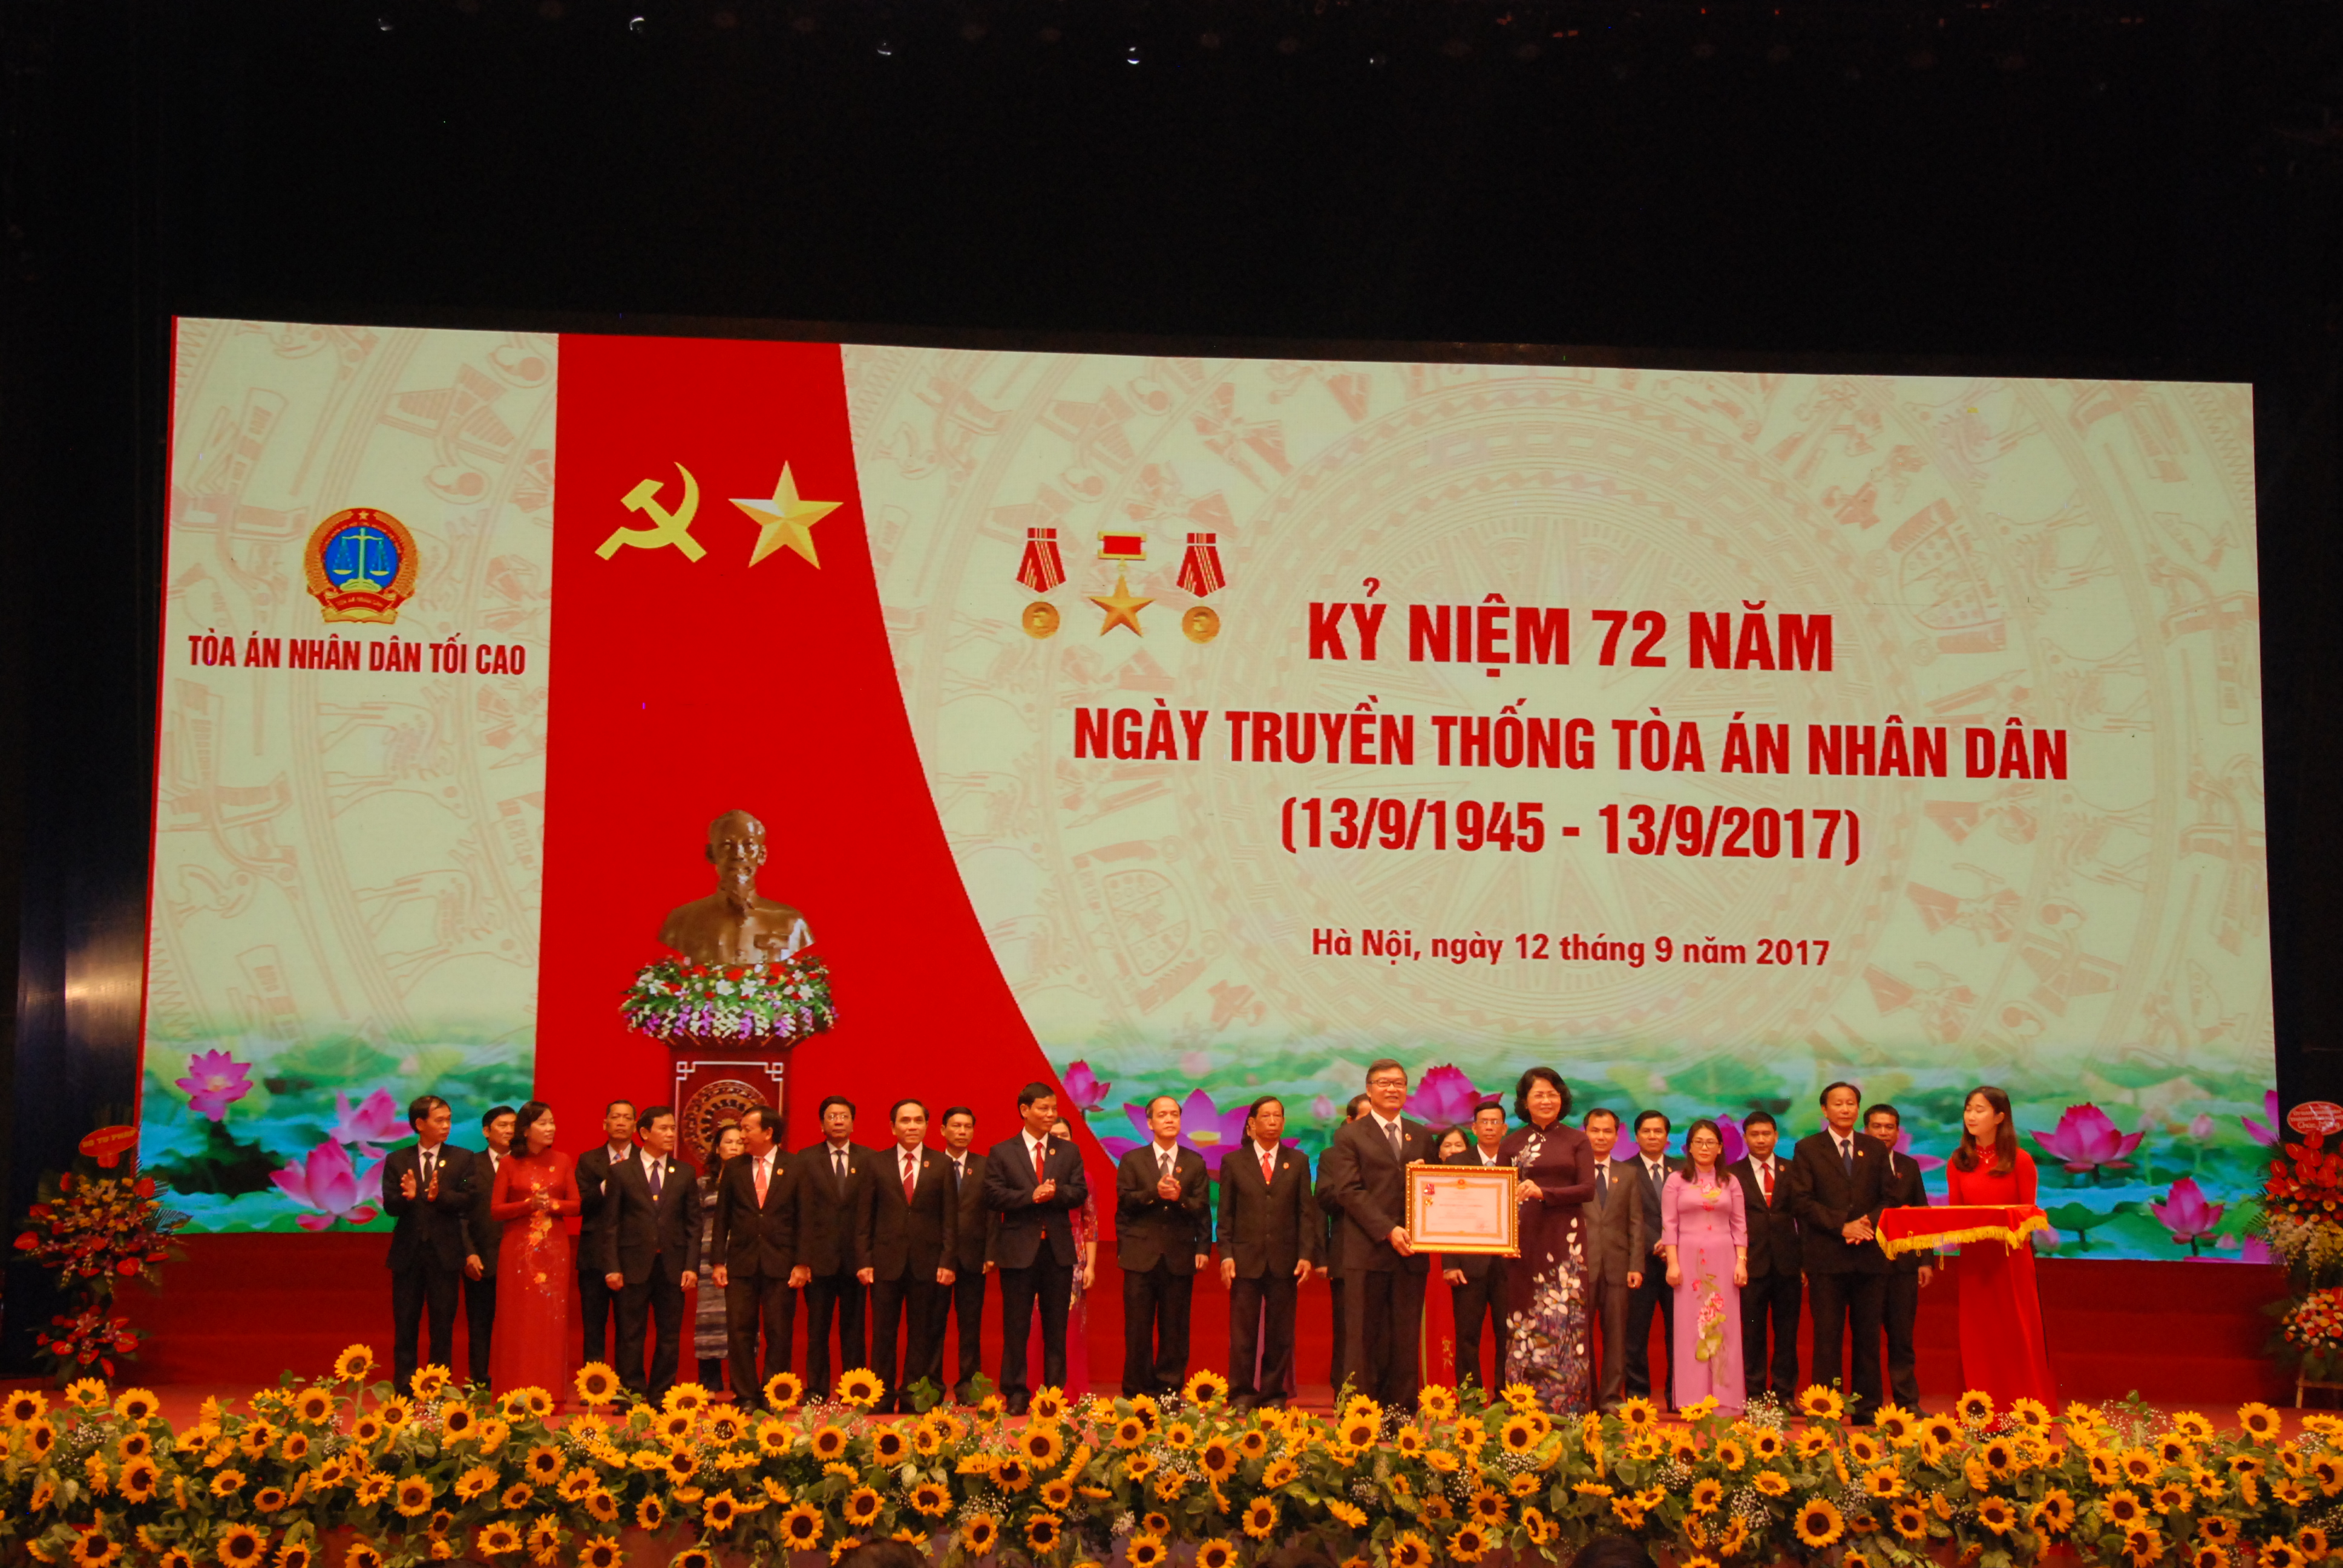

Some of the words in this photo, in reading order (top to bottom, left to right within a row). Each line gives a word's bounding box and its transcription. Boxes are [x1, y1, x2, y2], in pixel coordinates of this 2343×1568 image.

[189, 629, 235, 667] TÒA
[244, 631, 280, 668] ÁN
[289, 634, 360, 670] NHÂN
[370, 636, 421, 672] DÂN
[430, 633, 467, 673] TỐI
[476, 644, 525, 675] CAO
[1309, 578, 1386, 660] KỶ
[1410, 593, 1569, 677] NIỆM
[1592, 610, 1666, 667] 72
[1689, 600, 1832, 671] NĂM
[1075, 698, 1208, 760] NGÀY
[1226, 695, 1413, 765] TRUYỀN
[1432, 699, 1594, 769] THỐNG
[1612, 707, 1705, 772] TÒA
[1721, 712, 1789, 774] ÁN
[1809, 715, 1947, 777] NHÂN
[1966, 717, 2066, 780] DÂN
[1283, 797, 1544, 853] (13/9/1945
[1599, 805, 1859, 866] 13/9/2017)
[1314, 929, 1351, 955] Hà
[1363, 930, 1420, 965] Nội,
[1432, 932, 1502, 964] ngày
[1516, 934, 1548, 959] 12
[1560, 933, 1644, 967] tháng
[1656, 936, 1673, 962] 9
[1684, 936, 1745, 963] năm
[1757, 939, 1829, 965] 2017
